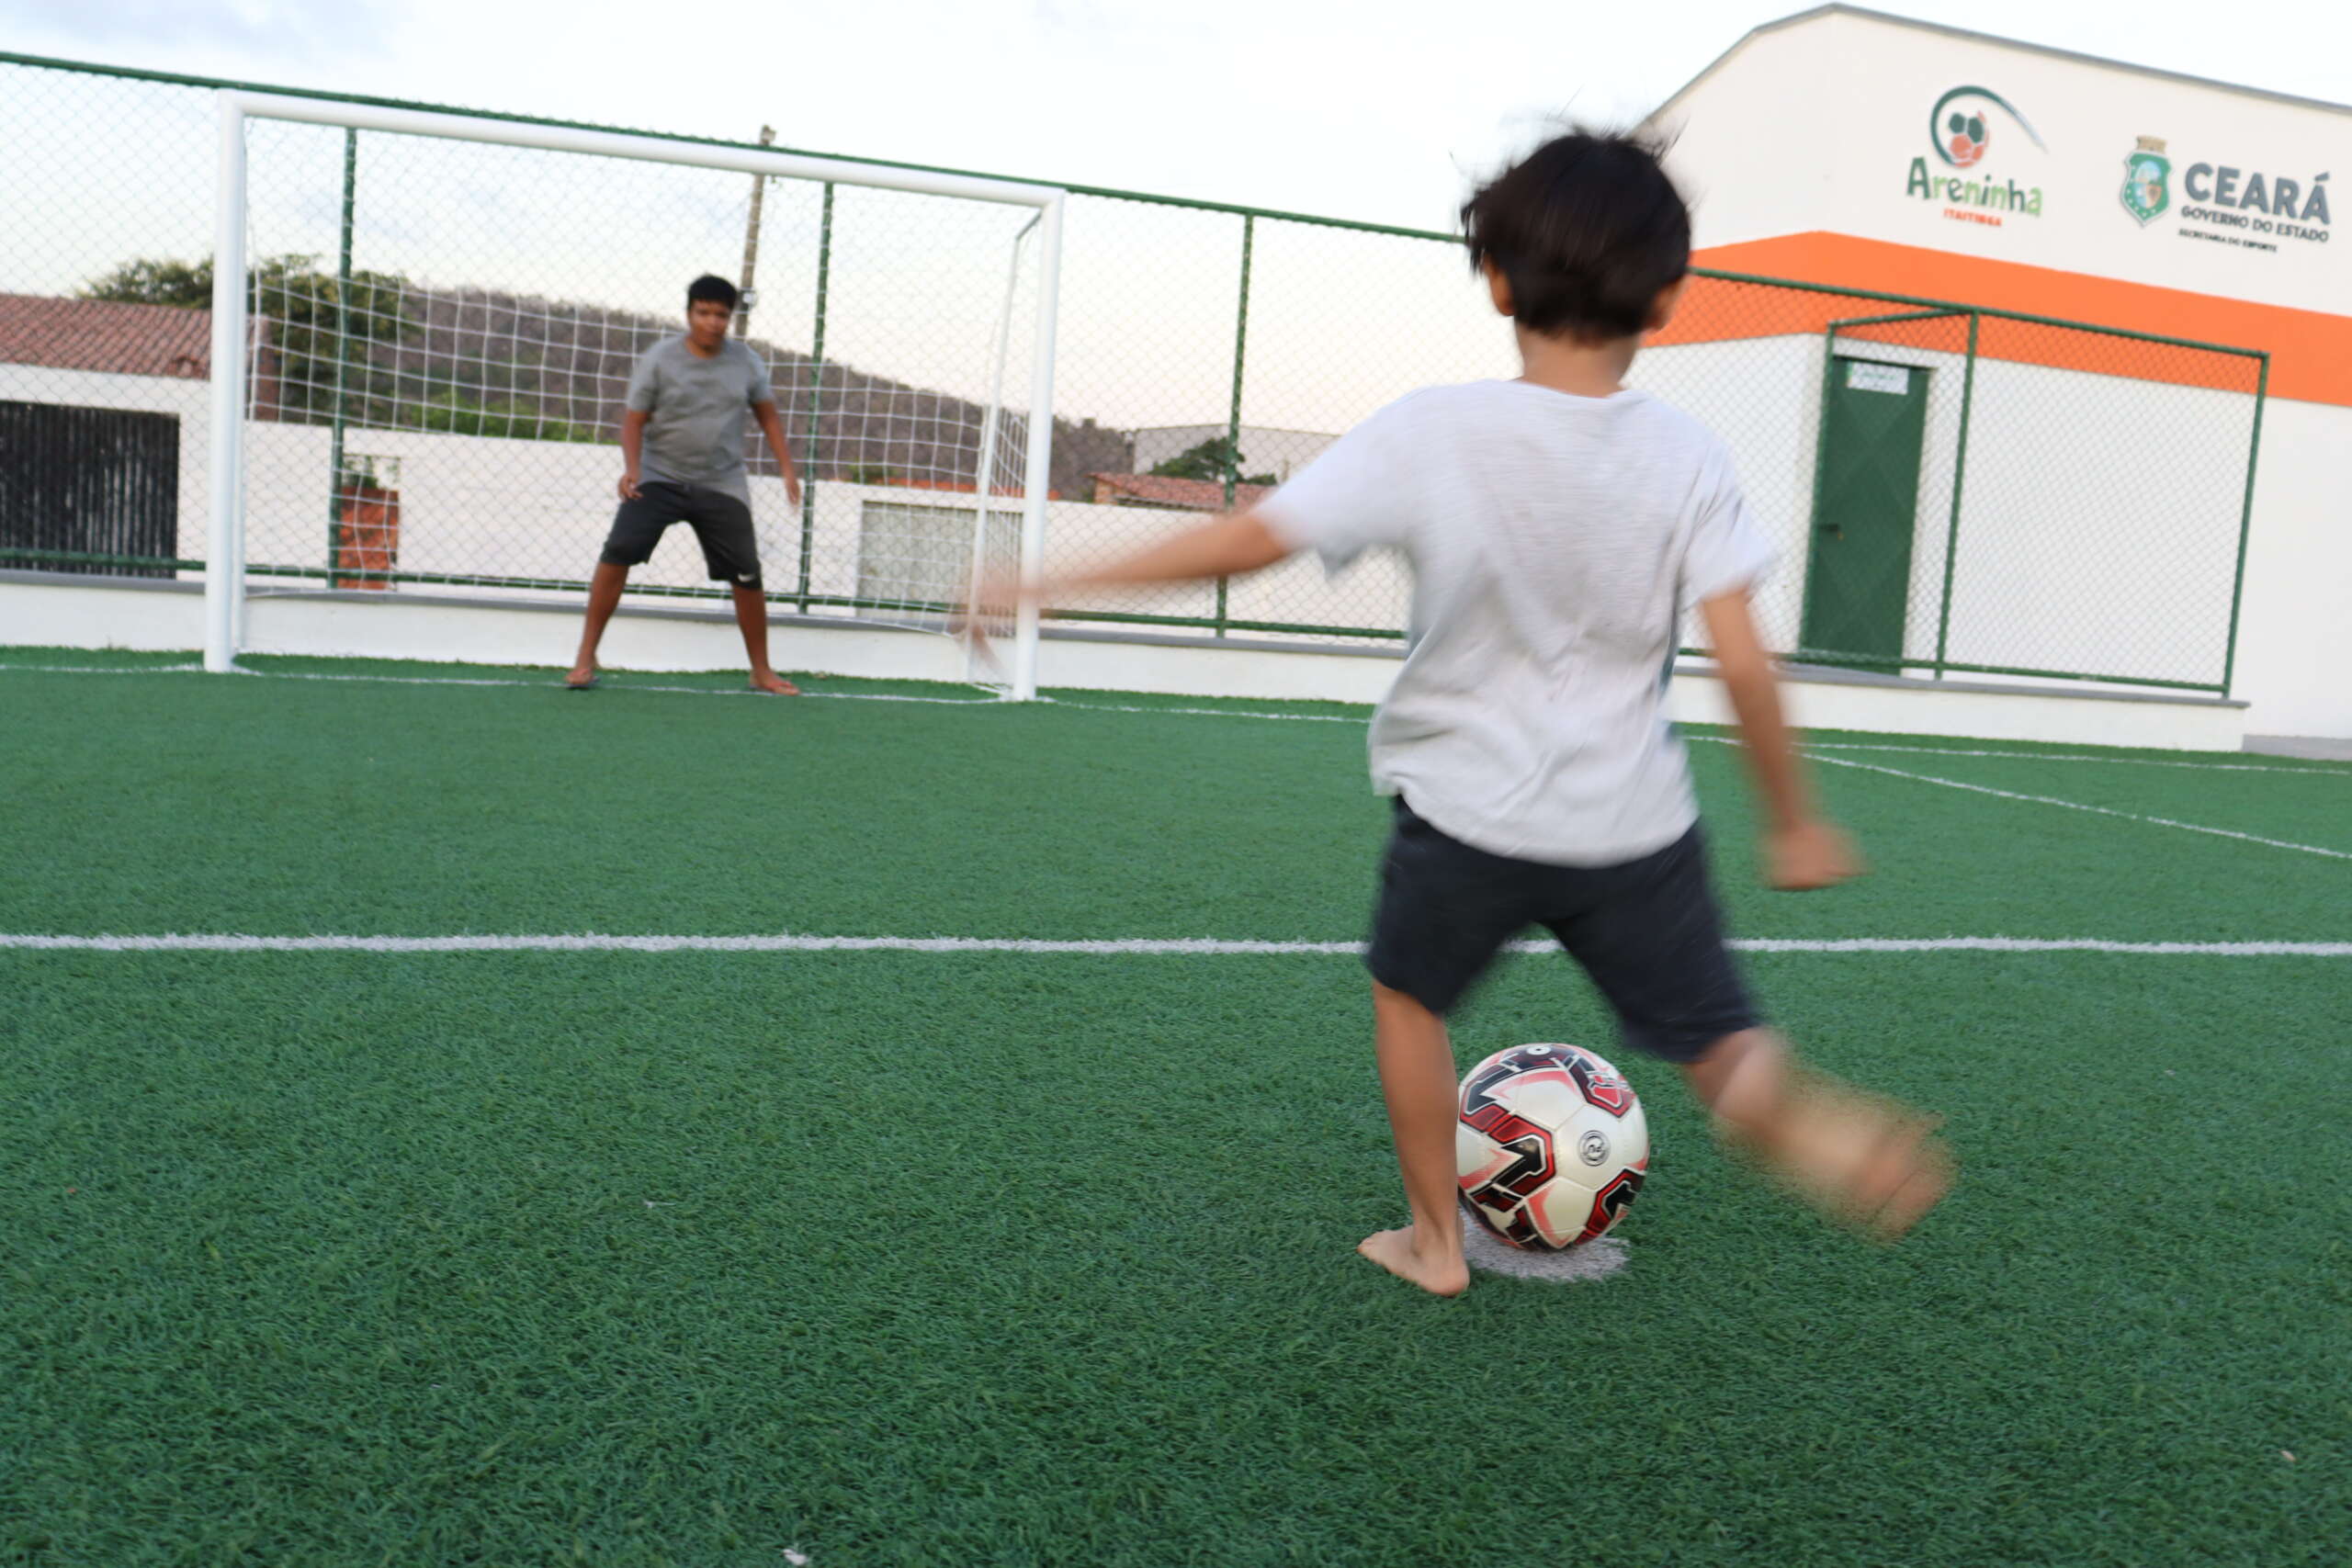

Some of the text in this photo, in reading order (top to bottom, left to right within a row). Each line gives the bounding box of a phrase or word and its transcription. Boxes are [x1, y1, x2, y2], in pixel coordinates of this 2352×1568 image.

[1906, 156, 2042, 217] Areninha
[2185, 162, 2331, 225] CEARÁ
[2181, 205, 2329, 243] GOVERNO DO ESTADO
